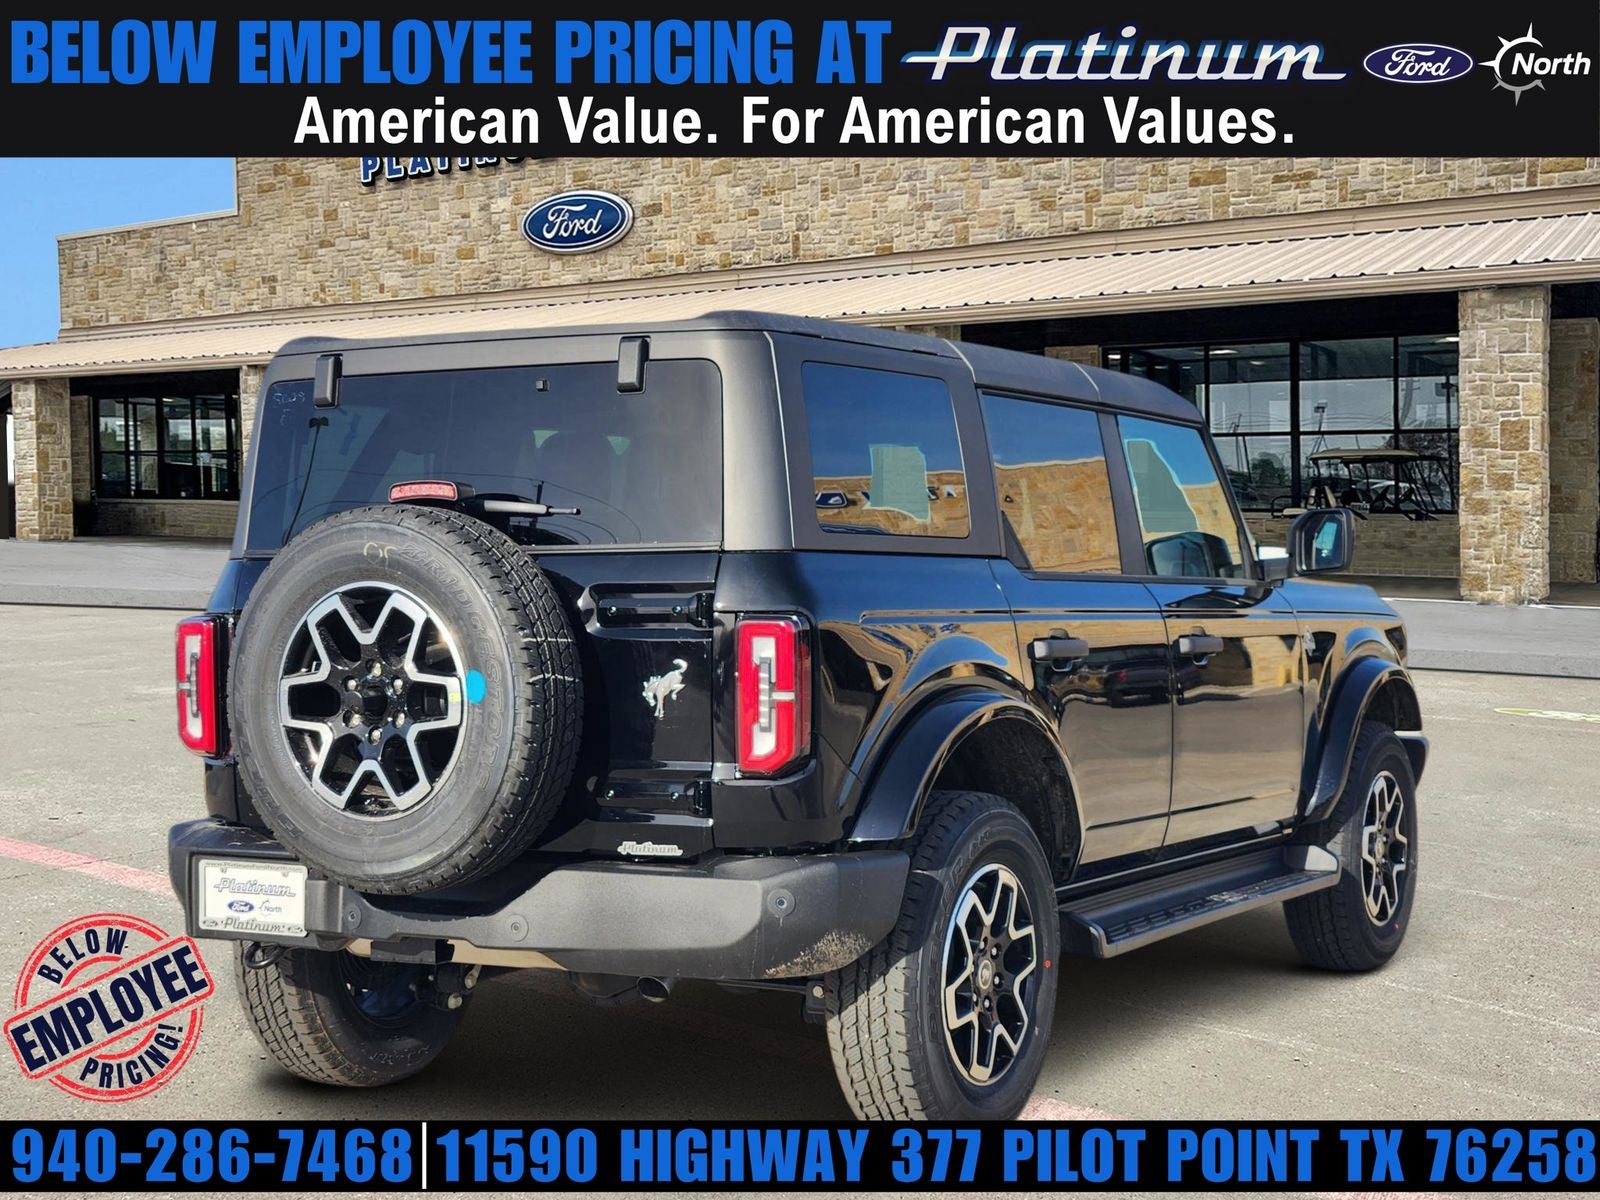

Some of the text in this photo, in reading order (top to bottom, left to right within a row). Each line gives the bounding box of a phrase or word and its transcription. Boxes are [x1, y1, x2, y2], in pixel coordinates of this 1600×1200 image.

[543, 203, 602, 239] Ford
[617, 841, 683, 857] Platinum
[213, 877, 297, 898] Platinum
[263, 905, 283, 913] North
[224, 917, 281, 933] Platinum
